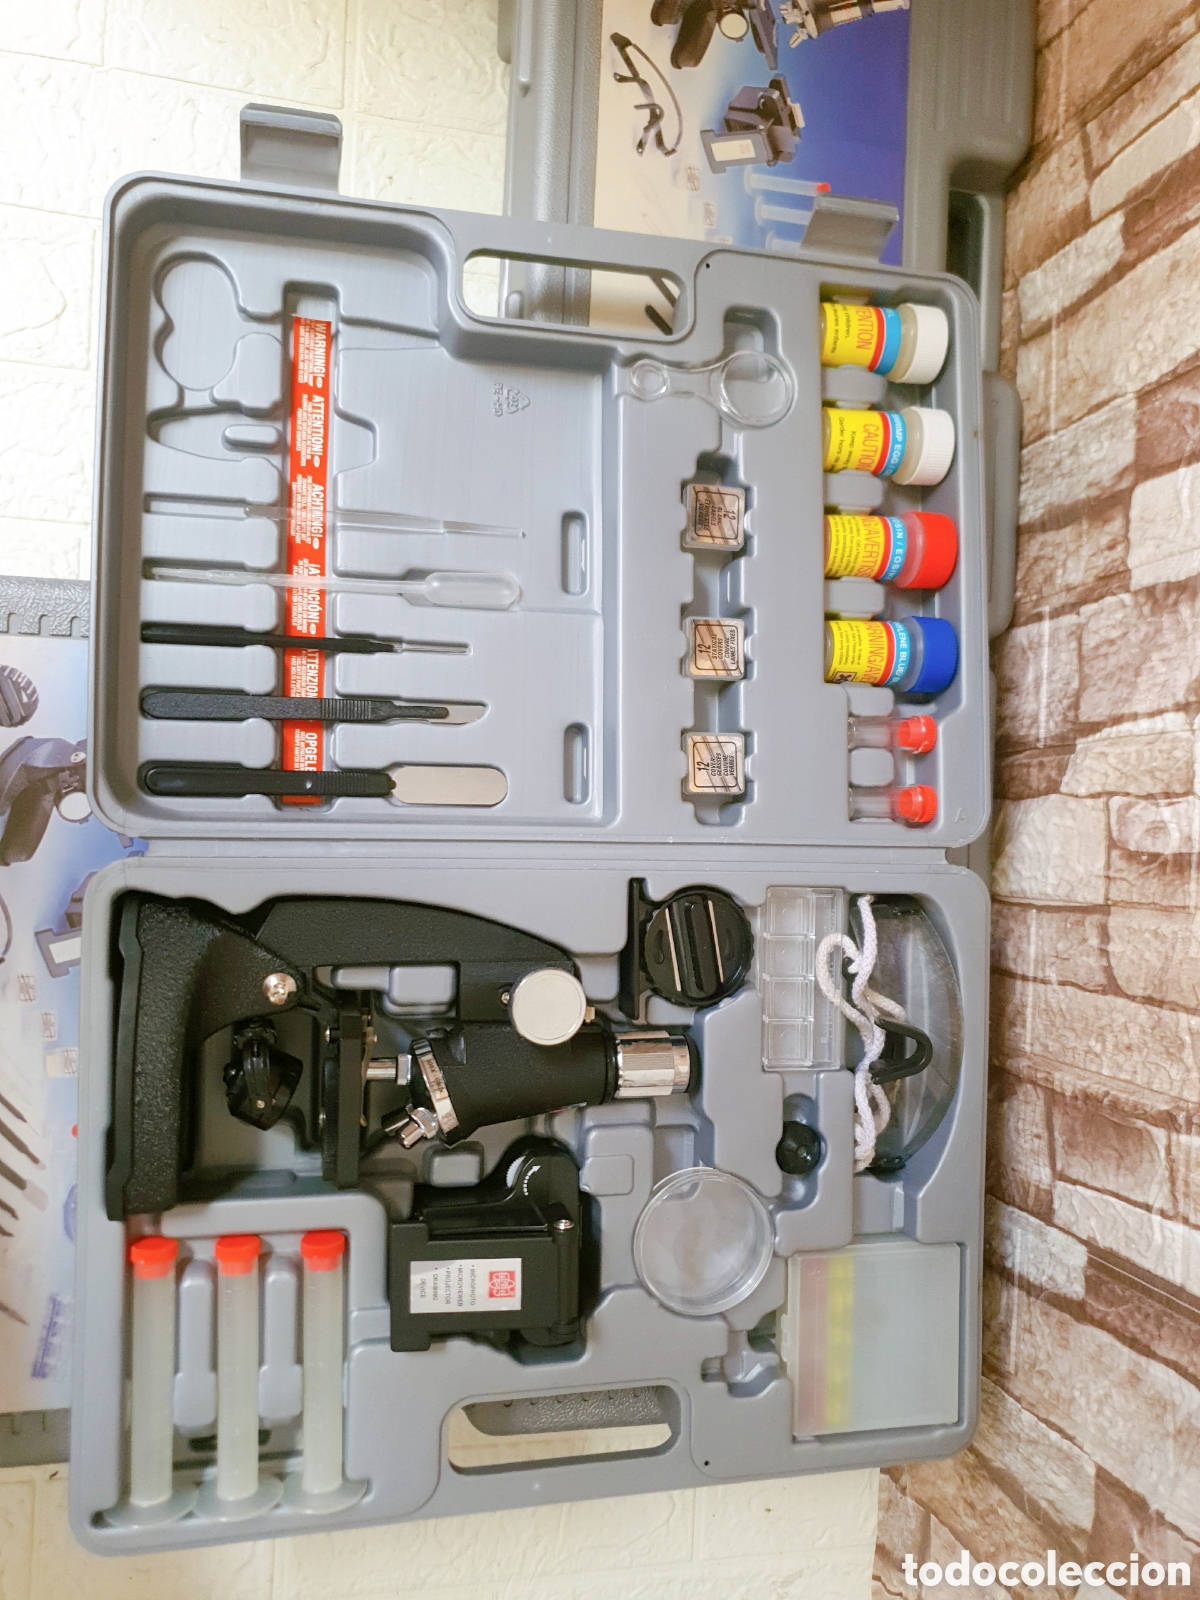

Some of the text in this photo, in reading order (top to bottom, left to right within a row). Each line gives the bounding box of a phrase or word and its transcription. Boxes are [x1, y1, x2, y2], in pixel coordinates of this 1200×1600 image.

[314, 323, 327, 378] WARNING!
[312, 394, 325, 456] ATTENTION!
[848, 430, 857, 448] Keep
[854, 424, 880, 472] CAUTION
[890, 444, 901, 465] EGG
[722, 509, 736, 520] 12
[697, 643, 711, 653] 12
[696, 761, 710, 772] 12
